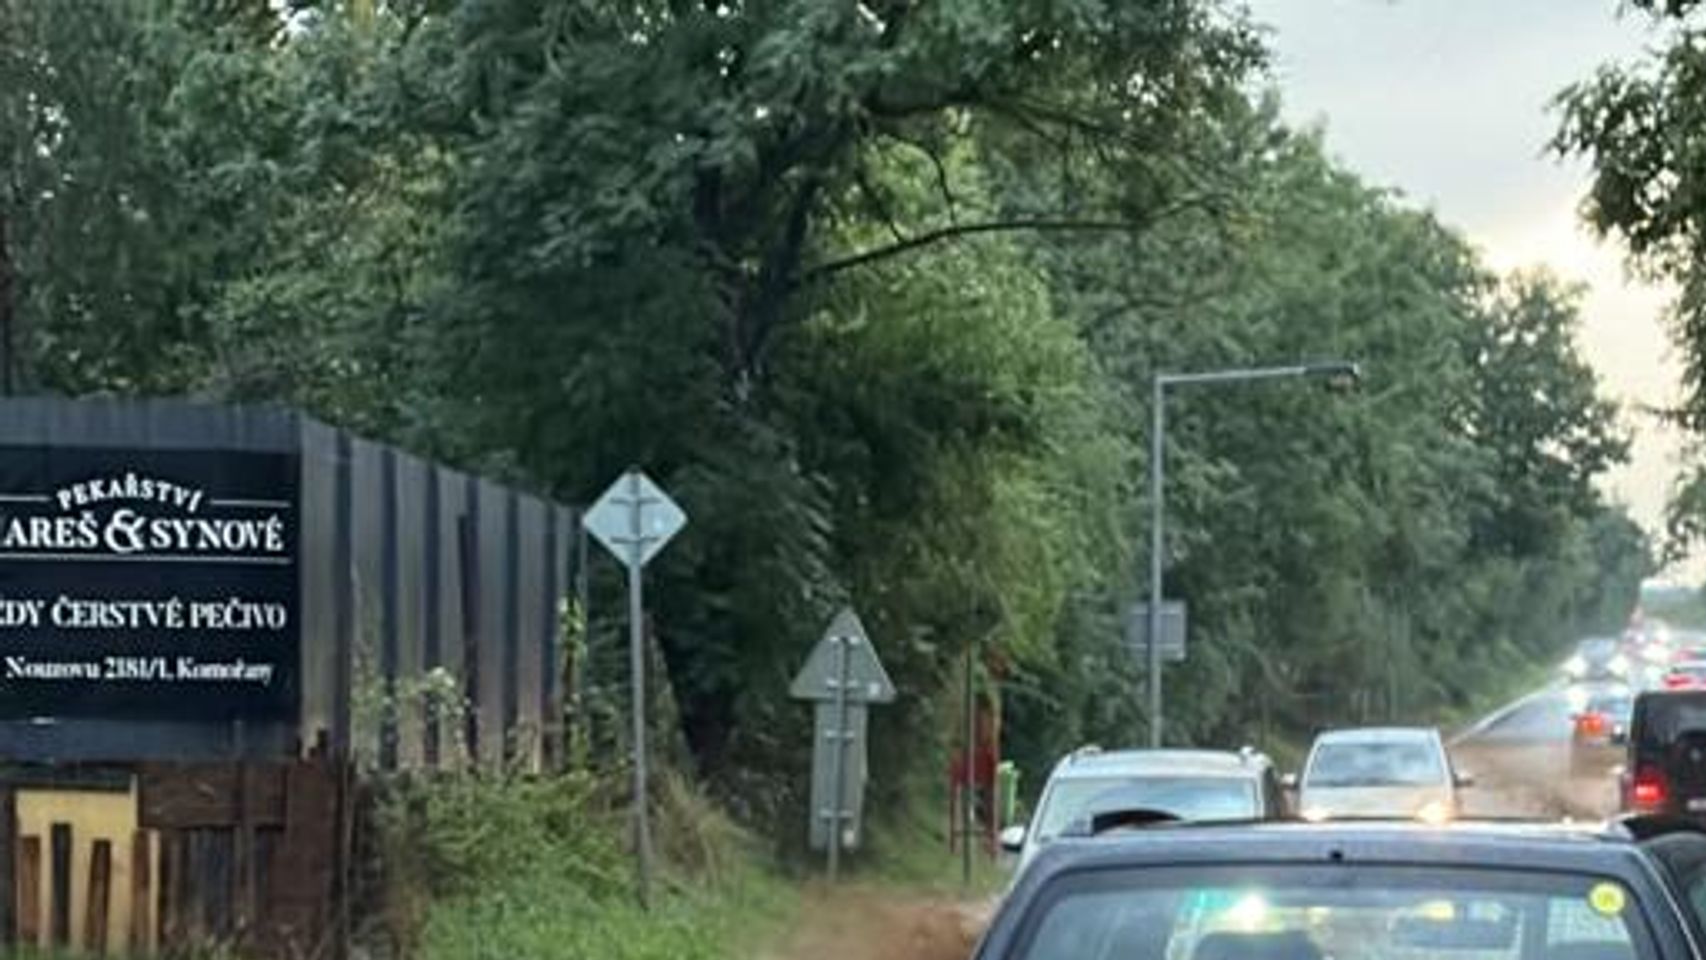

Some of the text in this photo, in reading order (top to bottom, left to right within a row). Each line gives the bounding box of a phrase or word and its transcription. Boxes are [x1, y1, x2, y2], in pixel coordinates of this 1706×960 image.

[57, 472, 202, 512] PEKAŘSTVÍ
[0, 509, 284, 553] AREŠ & SYNOVÉ
[51, 595, 184, 628] ČERSTVÉ
[190, 597, 287, 628] PEČIVO
